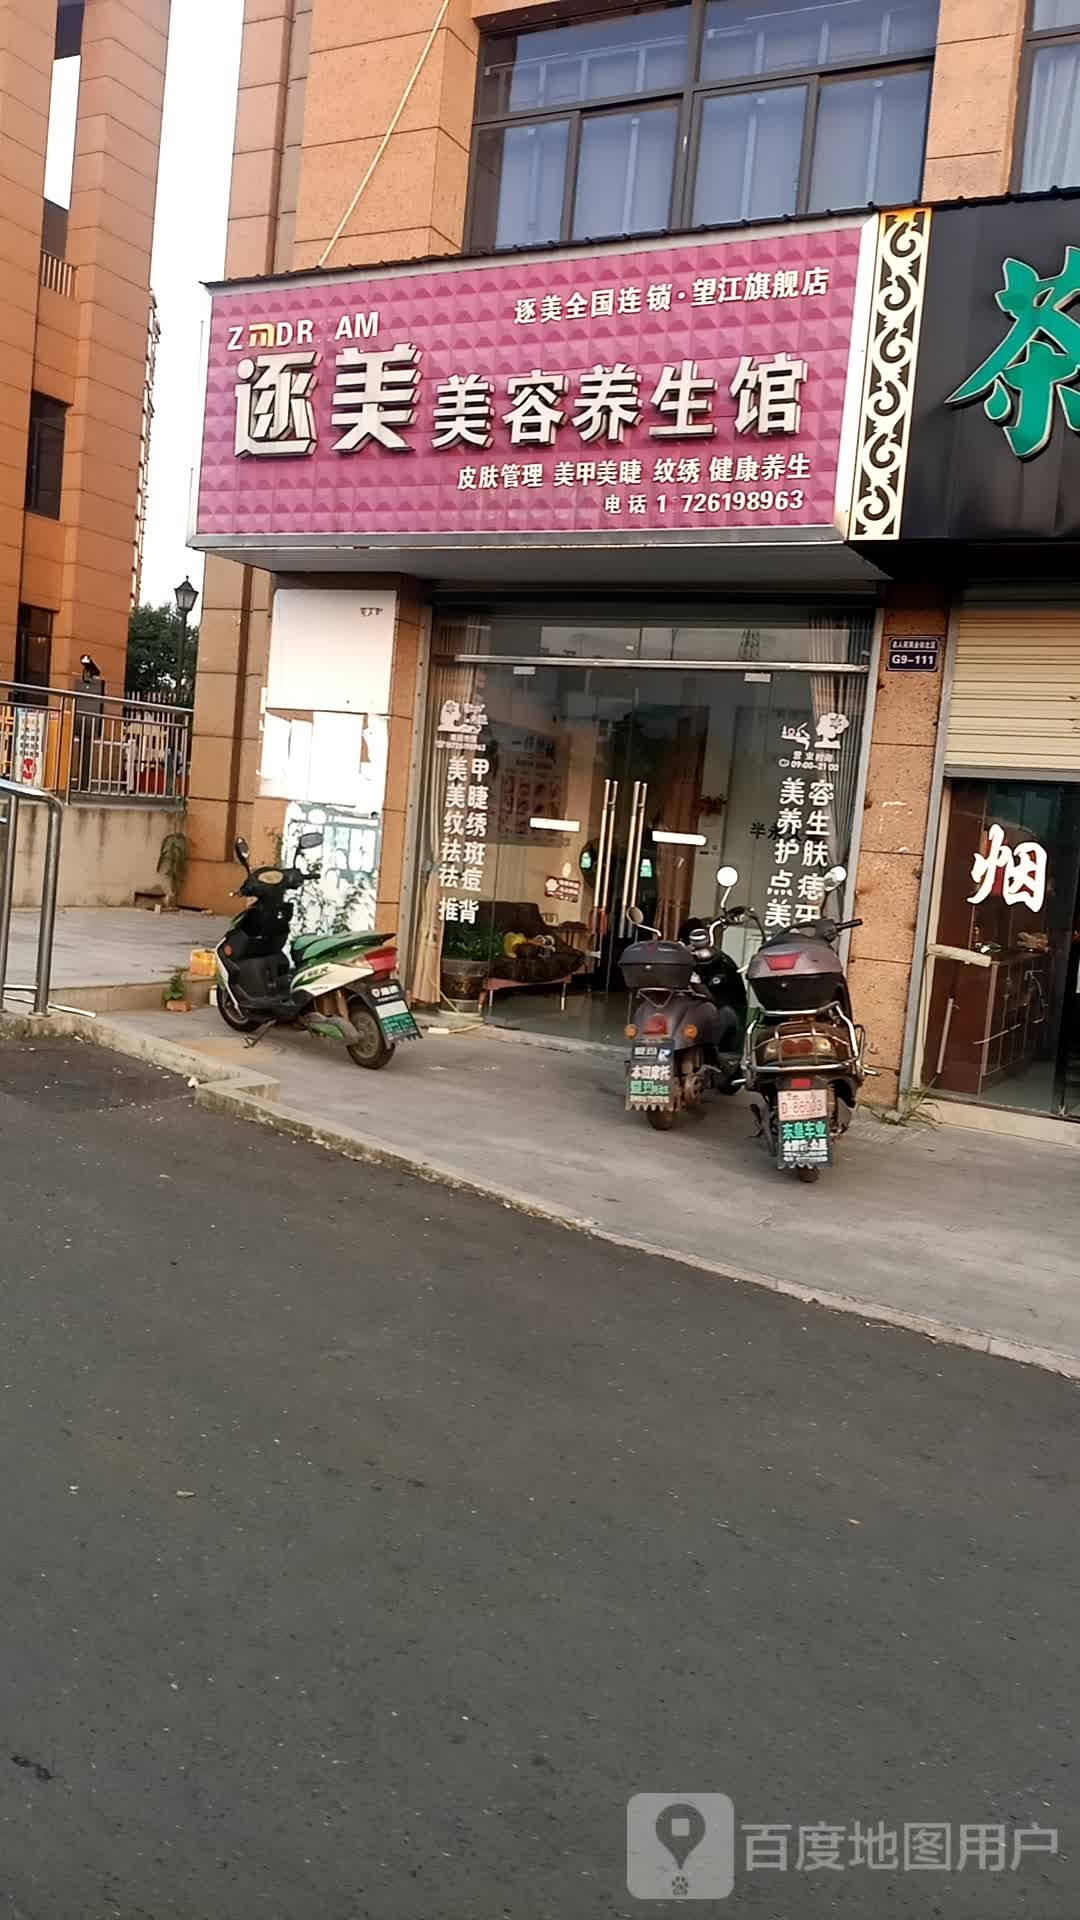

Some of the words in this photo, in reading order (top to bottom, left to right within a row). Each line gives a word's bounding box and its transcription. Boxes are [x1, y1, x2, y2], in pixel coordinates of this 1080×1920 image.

[944, 246, 1080, 458] 茶
[431, 352, 807, 452] 美容养生馆
[457, 463, 543, 490] 皮肤管理
[554, 459, 641, 486] 美甲美睫
[653, 457, 700, 483] 纹绣
[709, 453, 810, 482] 健康养生
[605, 494, 647, 514] 电话
[892, 654, 934, 665] G9-111
[447, 757, 490, 782] 美甲
[445, 785, 488, 810] 美睫
[779, 777, 834, 806] 美容
[443, 811, 487, 837] 纹绣
[777, 808, 830, 836] 养生
[440, 838, 485, 865] 祛斑
[774, 839, 829, 866] 护肤
[438, 863, 482, 891] 祛痘
[967, 824, 1047, 912] 烟
[767, 869, 826, 900] 点痣
[438, 898, 479, 924] 推背
